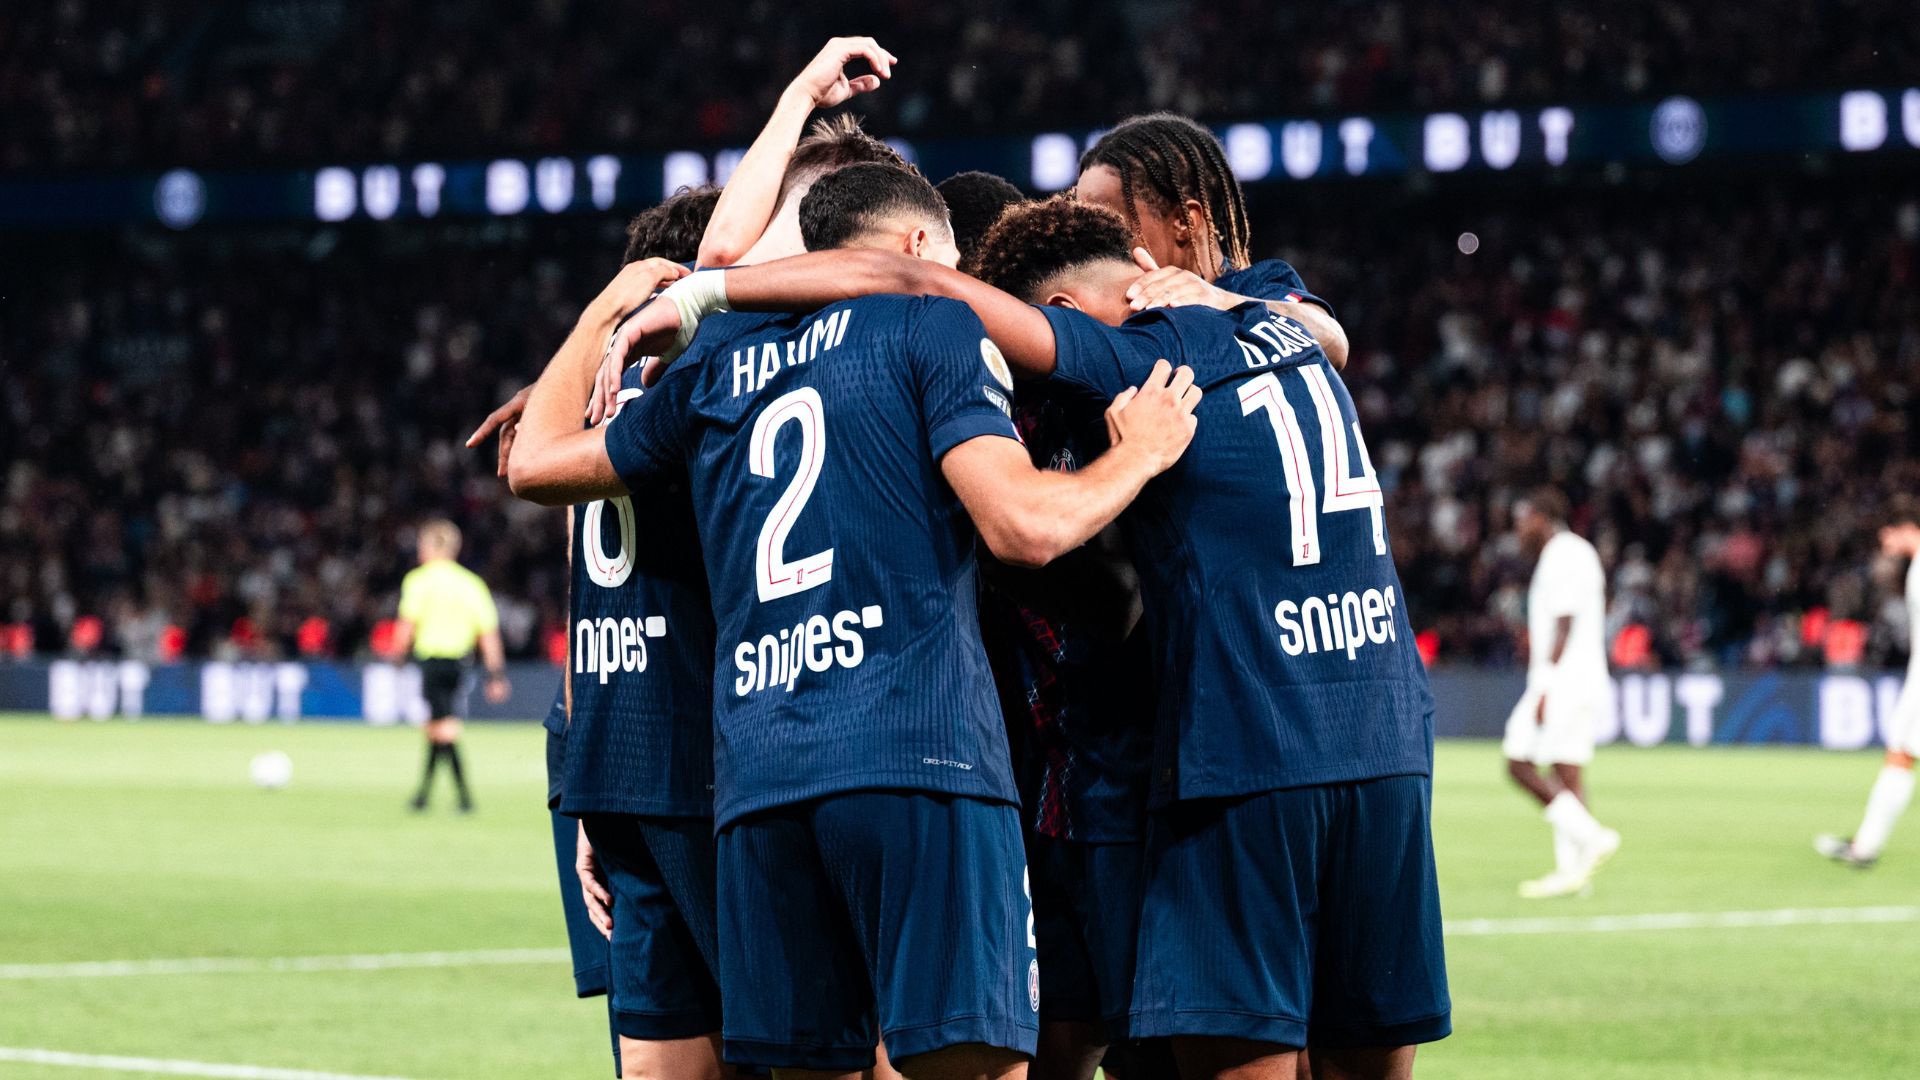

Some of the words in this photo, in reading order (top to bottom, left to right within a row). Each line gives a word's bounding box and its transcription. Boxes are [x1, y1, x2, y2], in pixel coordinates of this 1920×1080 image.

[1226, 117, 1375, 182] BUT
[1424, 107, 1574, 172] BUT
[314, 162, 446, 222] BUT
[486, 154, 622, 215] BUT
[749, 386, 834, 603] 2
[1237, 364, 1386, 566] 14
[735, 609, 864, 697] snipes
[1274, 585, 1396, 661] snipes
[50, 661, 149, 721] BUT
[202, 661, 307, 723] BUT
